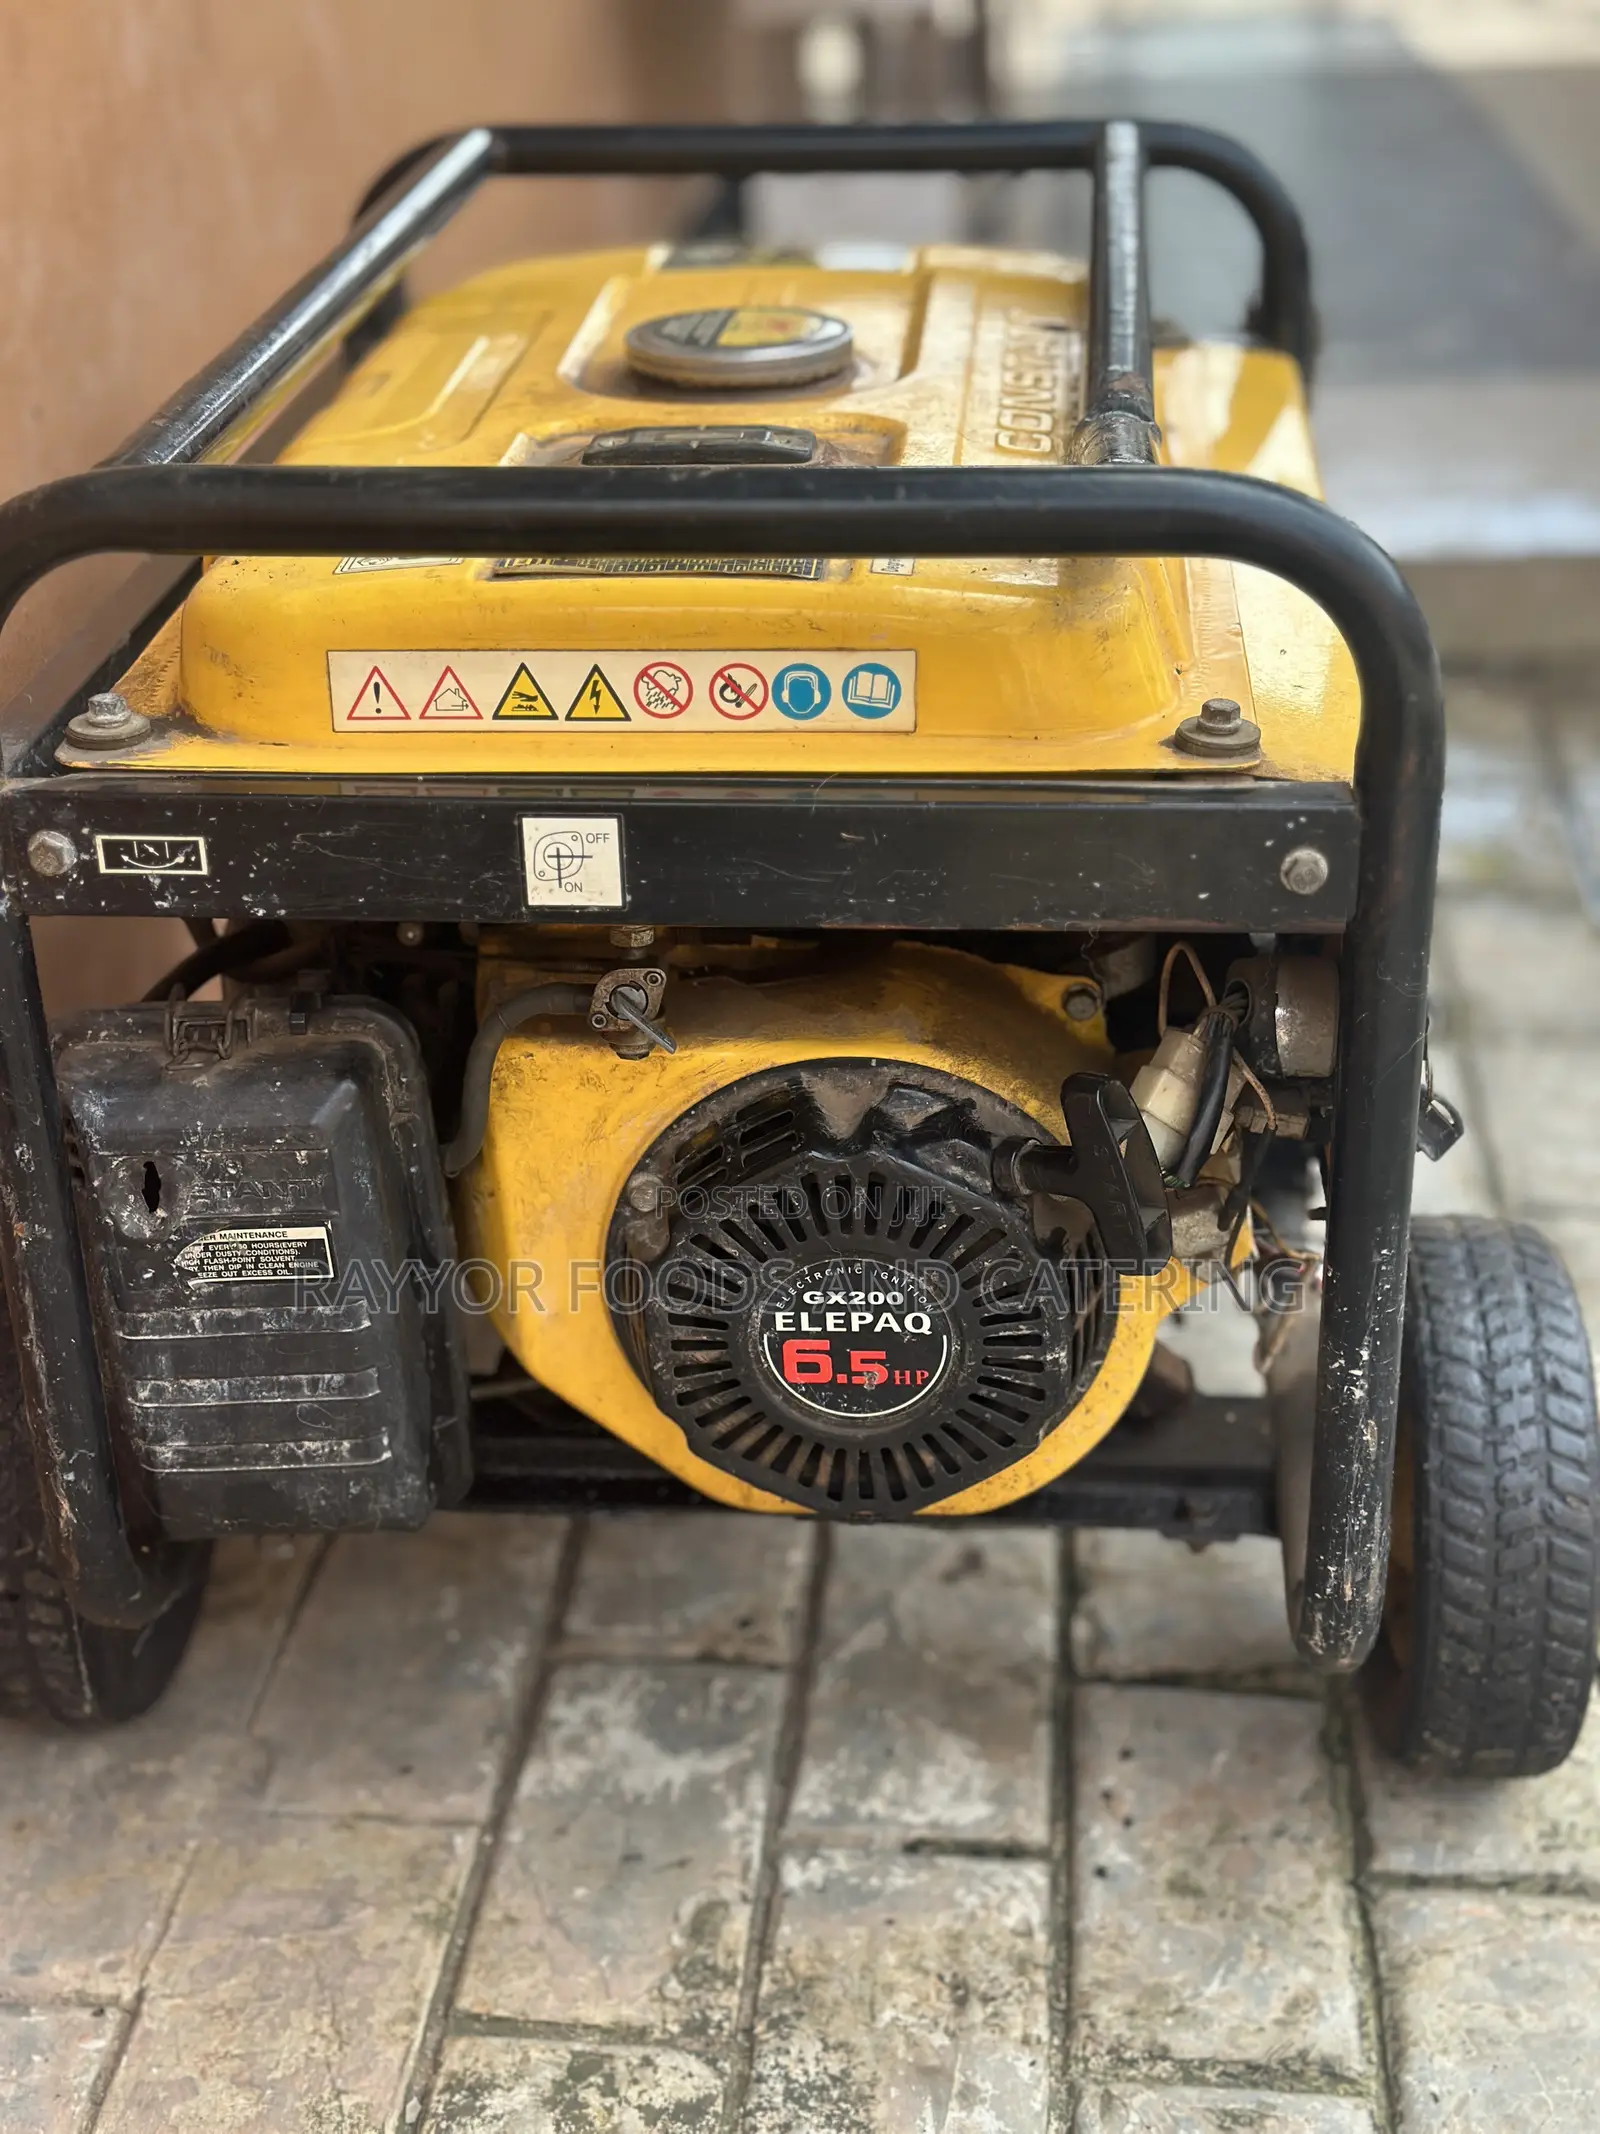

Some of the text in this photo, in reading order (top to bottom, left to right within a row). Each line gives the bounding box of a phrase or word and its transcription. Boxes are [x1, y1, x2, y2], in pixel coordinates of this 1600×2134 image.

[586, 833, 610, 844] OFF
[564, 881, 582, 893] ON
[219, 1231, 288, 1240] MAINTENANCE
[246, 1248, 300, 1256] CONDITIONS).
[181, 1259, 200, 1267] HIGH
[204, 1257, 256, 1265] FLASH-POINT
[203, 1264, 225, 1272] THEN
[277, 1268, 293, 1276] OIL.
[776, 1266, 934, 1313] ELECTRONIC IGNITION
[803, 1291, 904, 1306] GX200
[774, 1312, 933, 1335] ELEPAQ
[782, 1338, 929, 1387] 6.5 HP
